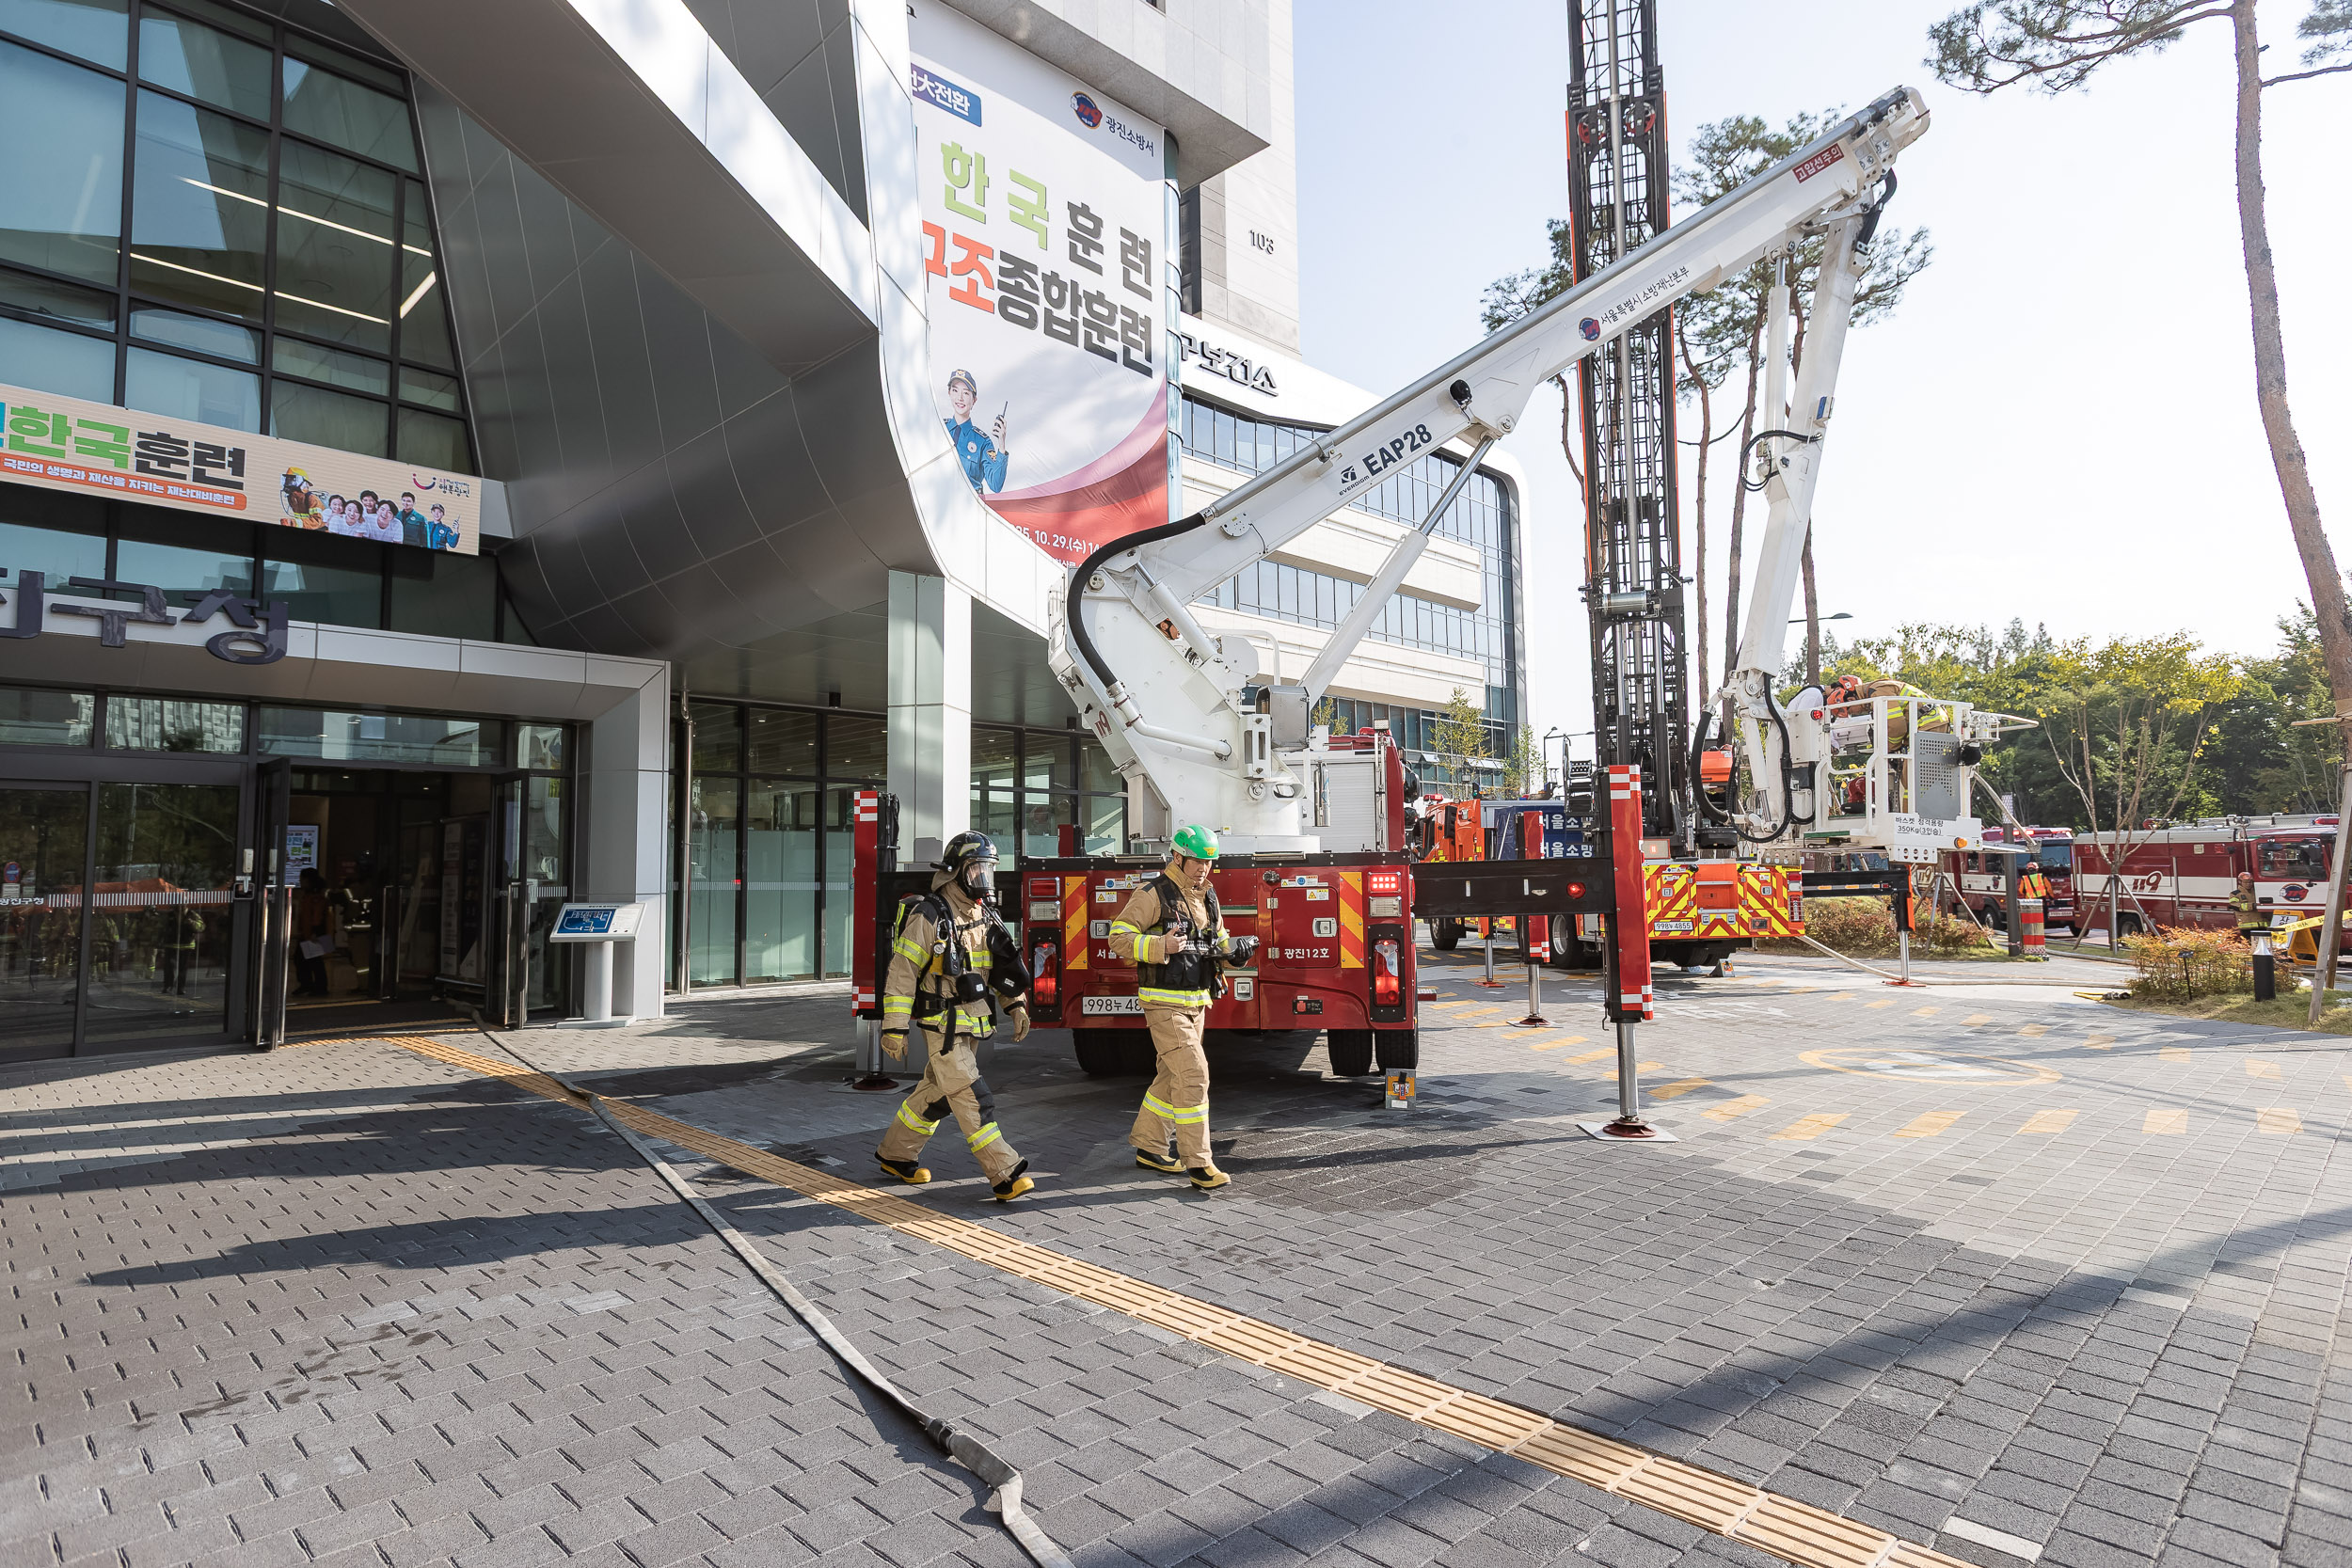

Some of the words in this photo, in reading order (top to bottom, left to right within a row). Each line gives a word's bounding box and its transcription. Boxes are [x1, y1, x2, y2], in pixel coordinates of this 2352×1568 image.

[1105, 115, 1154, 158] 광진소방서
[1795, 146, 1843, 181] 고압선주의
[1249, 230, 1274, 255] 103
[1600, 293, 1643, 325] 서울특별시
[1643, 266, 1690, 302] 소방재난본부
[0, 404, 246, 491] 한국훈련
[1362, 424, 1433, 477] EAP28
[4, 457, 44, 474] 국민의
[47, 464, 87, 482] 생명과
[88, 471, 126, 488] 재산을
[129, 478, 165, 495] 지키는
[167, 485, 236, 506] 재난대비훈련
[1339, 475, 1370, 496] EVERDIGM
[2132, 871, 2163, 893] 119
[0, 896, 44, 906] 광진구청
[1284, 947, 1329, 958] 광진12호
[1087, 998, 1123, 1012] 998누
